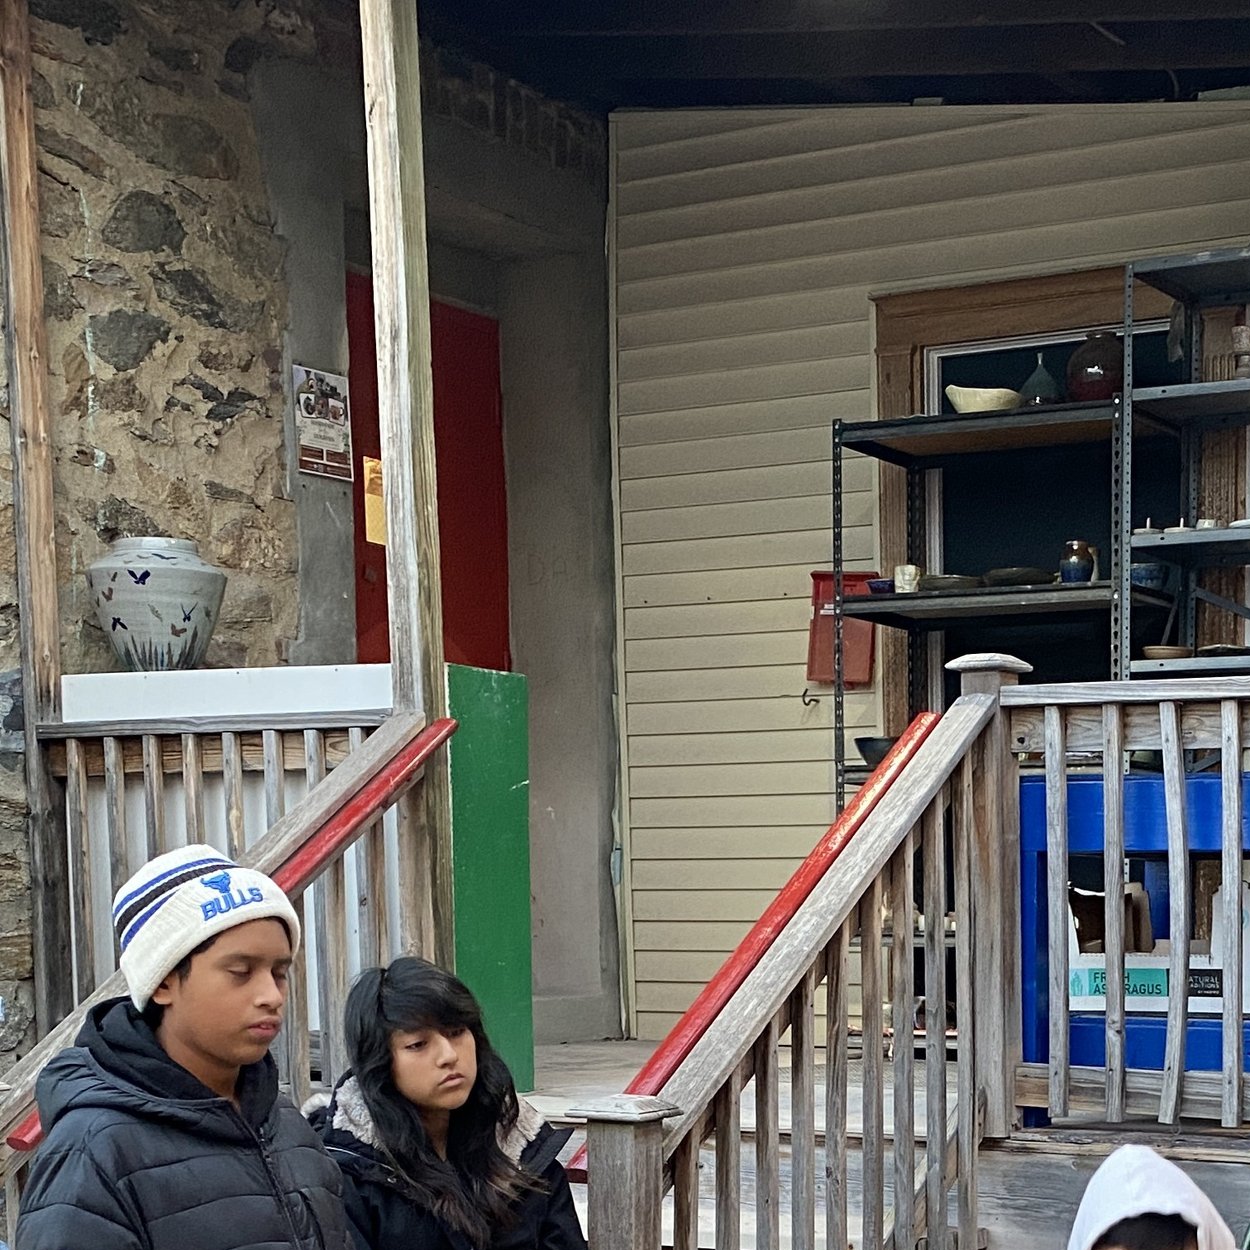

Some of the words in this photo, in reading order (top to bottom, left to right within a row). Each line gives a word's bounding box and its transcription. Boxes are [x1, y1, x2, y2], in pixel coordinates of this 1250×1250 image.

[200, 887, 264, 921] BULLS
[1093, 972, 1130, 983] FRH
[1093, 984, 1162, 995] ASRAGUS
